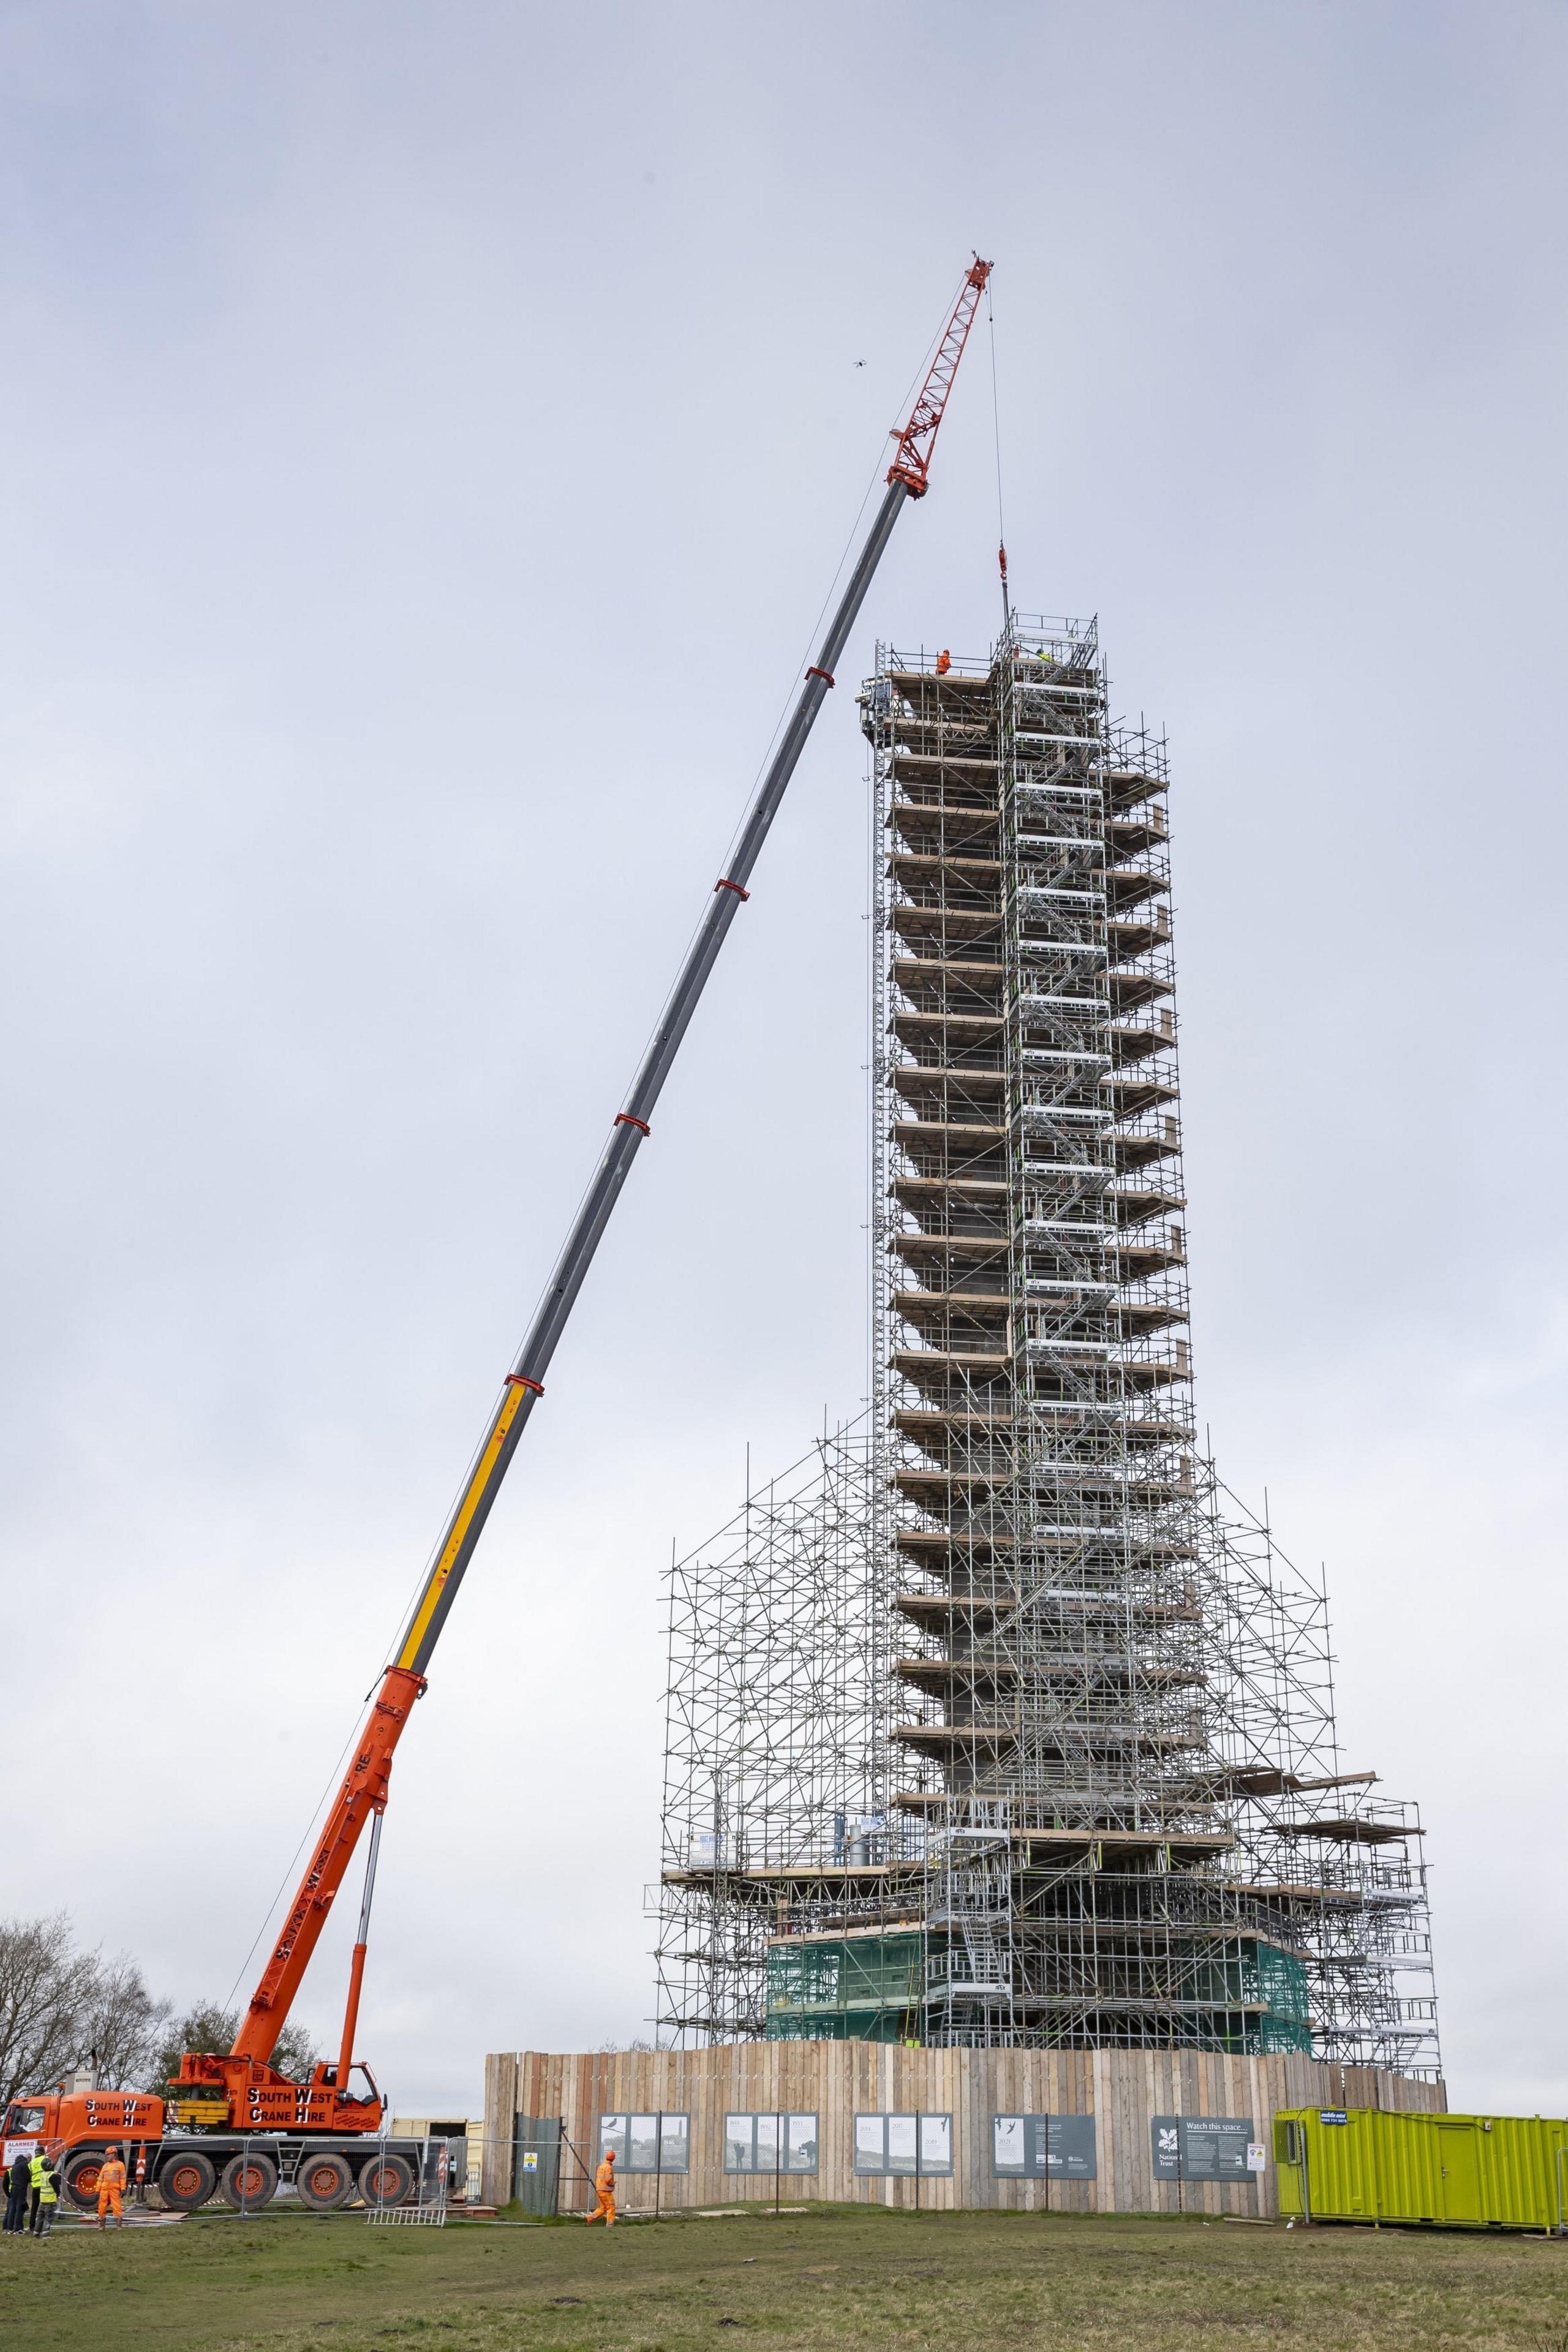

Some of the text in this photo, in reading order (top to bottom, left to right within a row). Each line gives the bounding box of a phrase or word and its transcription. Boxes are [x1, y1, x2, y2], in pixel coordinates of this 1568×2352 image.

[247, 2087, 333, 2105] SOUTH WEST
[85, 2098, 152, 2112] SOUTH WEST
[88, 2114, 147, 2127] CRANE HIRE
[249, 2106, 325, 2123] CRANE HIRE
